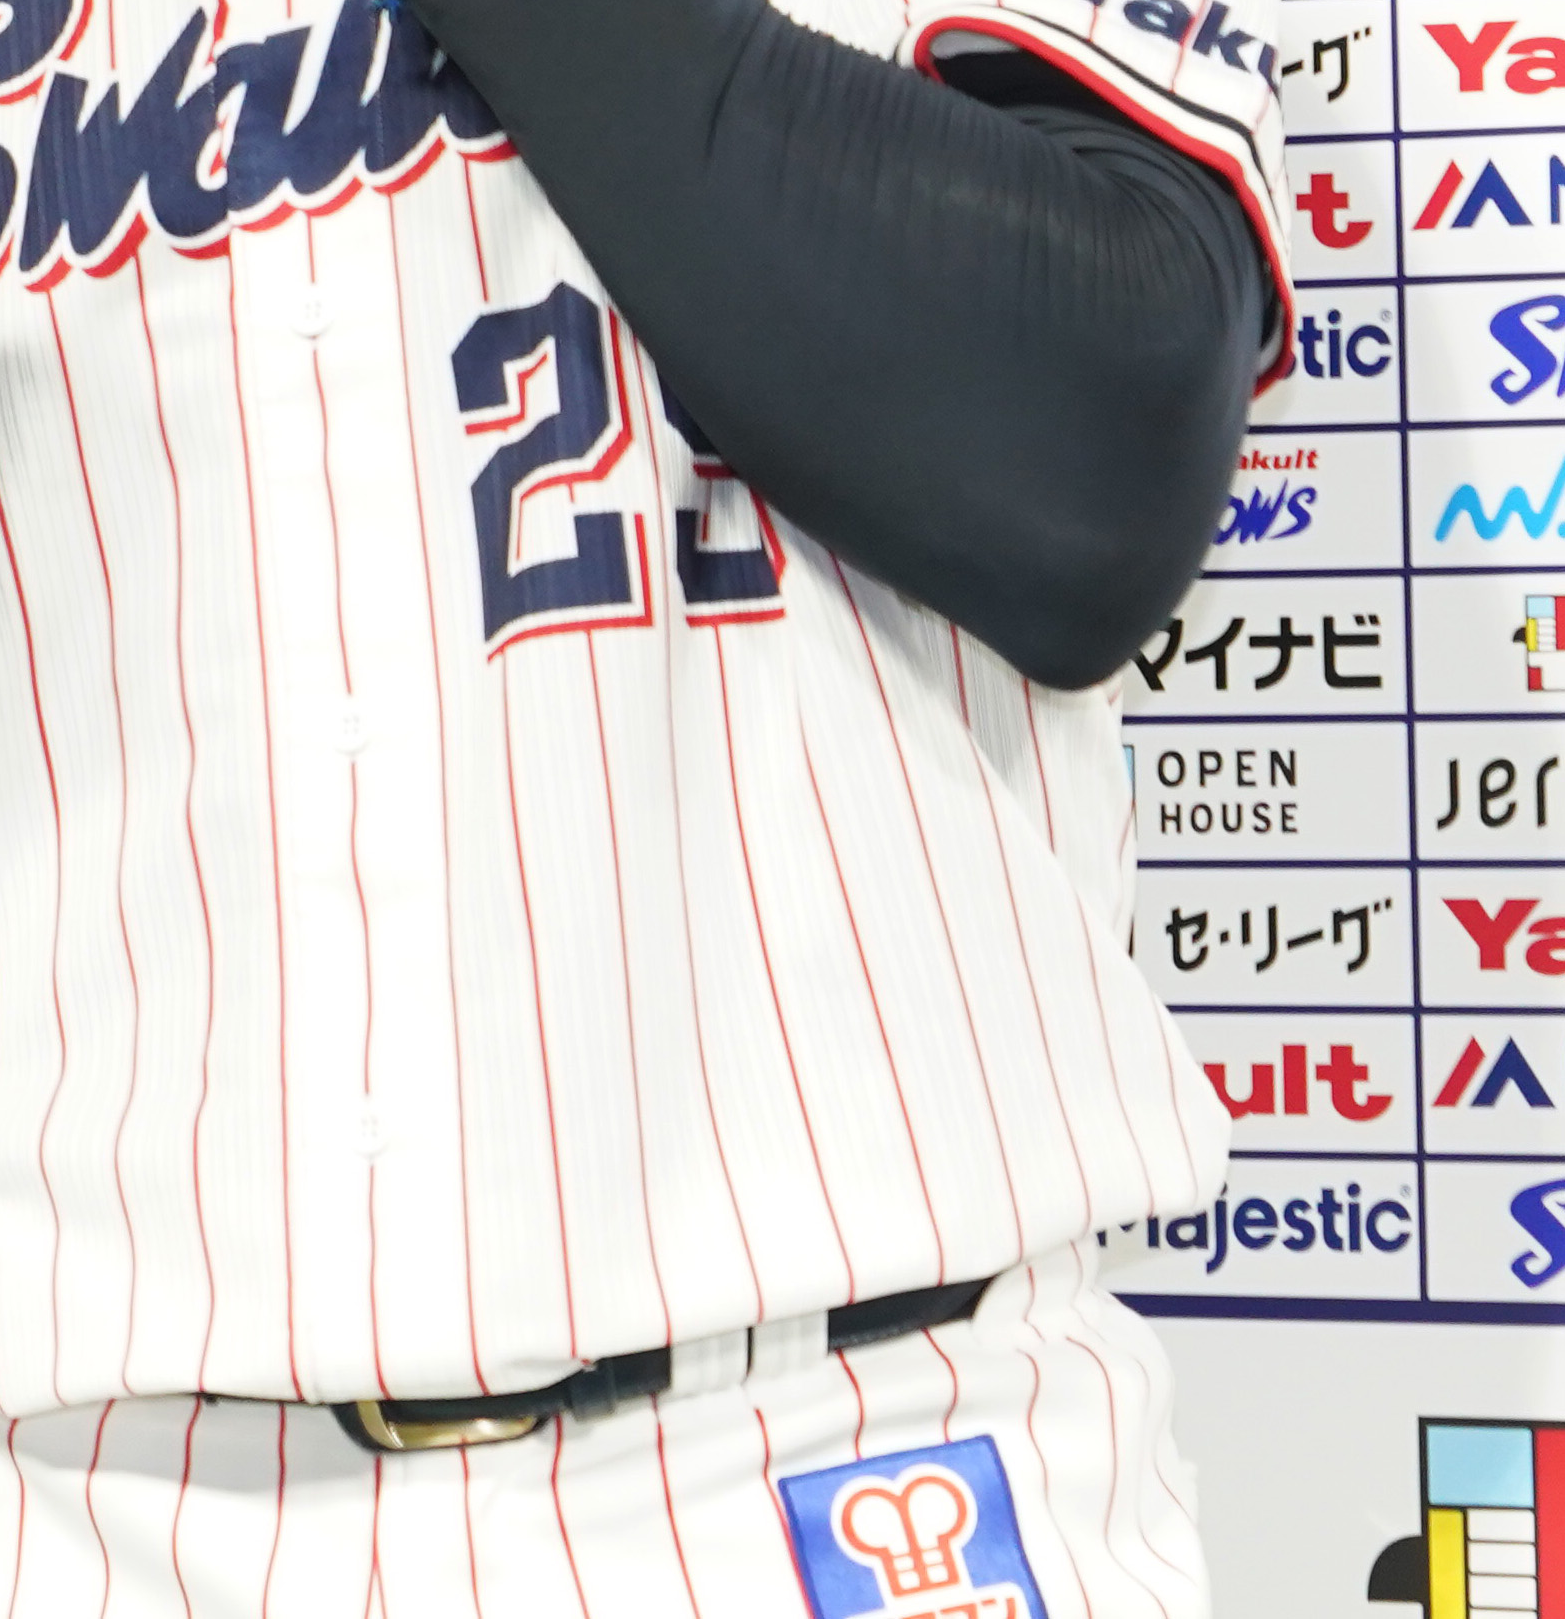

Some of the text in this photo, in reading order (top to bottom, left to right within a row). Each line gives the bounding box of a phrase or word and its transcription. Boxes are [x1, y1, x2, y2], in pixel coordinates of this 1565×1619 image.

[1132, 613, 1384, 693] マイナビ
[1157, 749, 1296, 788] OPEN
[1160, 802, 1298, 834] HOUSE
